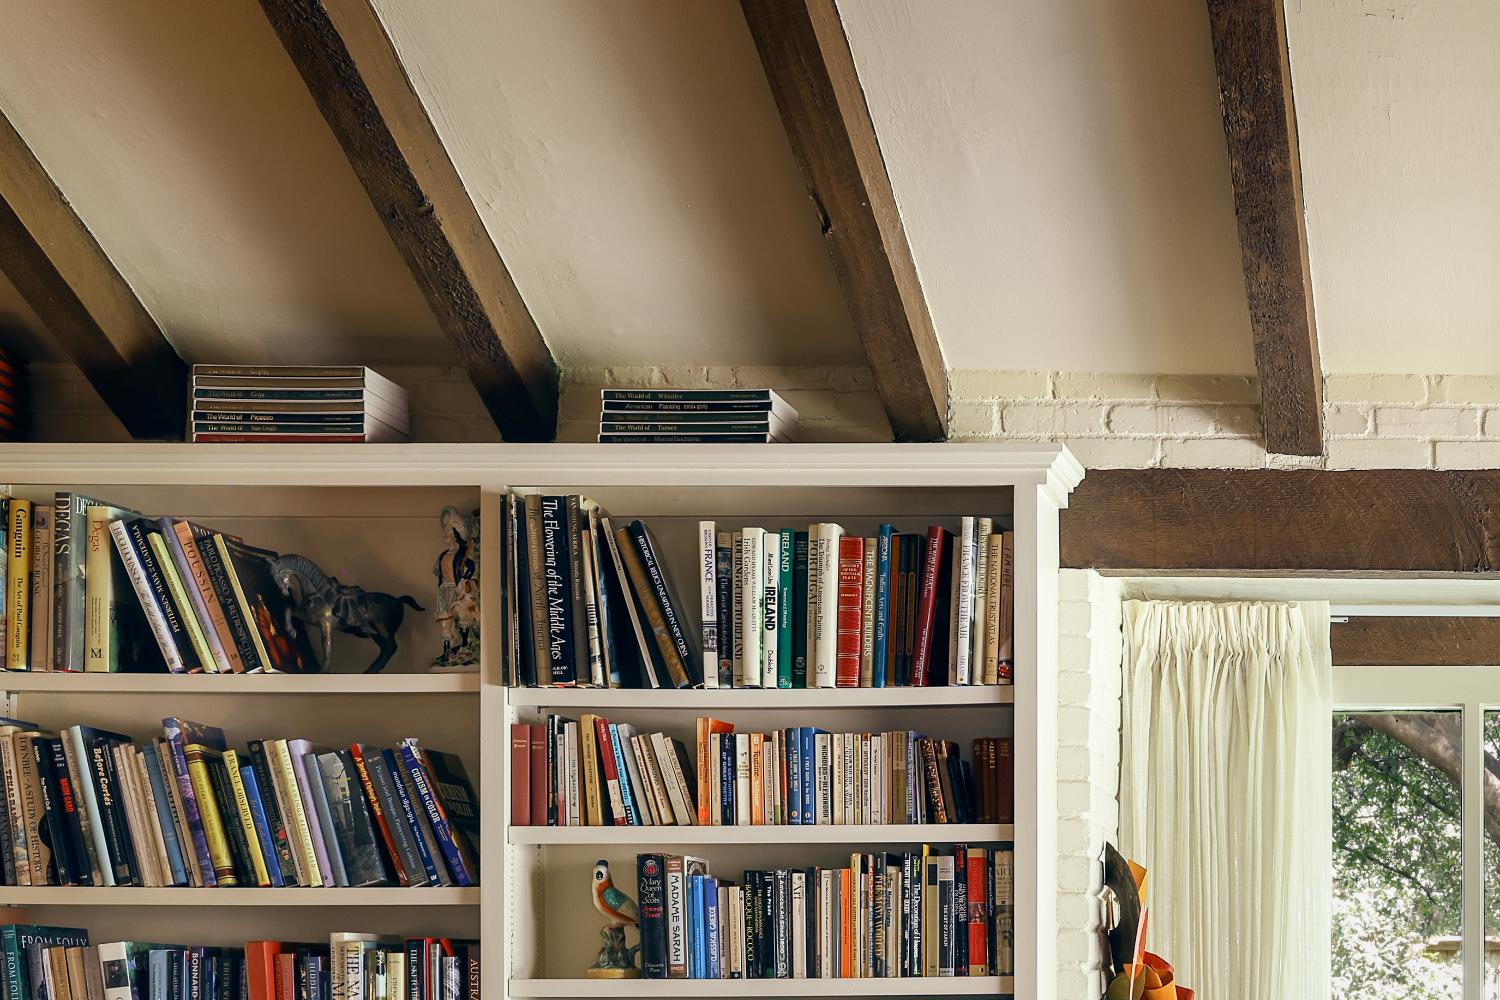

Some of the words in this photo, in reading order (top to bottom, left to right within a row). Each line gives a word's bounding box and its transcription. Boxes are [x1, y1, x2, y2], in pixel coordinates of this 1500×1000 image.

[55, 496, 70, 555] DEGAS
[543, 500, 558, 517] The
[12, 508, 27, 558] Gauguin
[91, 520, 104, 552] Degas
[544, 521, 562, 566] Flowering
[705, 549, 713, 582] FRANCE
[782, 532, 790, 572] IRELAND
[866, 550, 874, 566] THE
[962, 545, 970, 579] FRANCE
[183, 541, 214, 604] POUSSIN
[546, 569, 562, 578] of
[548, 581, 562, 595] the
[808, 539, 818, 608] PORTUGAL
[990, 560, 998, 599] NATIONAL
[637, 536, 654, 568] HISTORICAL
[670, 624, 681, 637] NEW
[677, 638, 688, 657] CHINA
[765, 586, 775, 631] IRELAND
[865, 567, 873, 620] MAGNIFICENT
[961, 580, 969, 604] FROM
[550, 598, 564, 633] Middle
[989, 601, 997, 622] TRUST
[550, 634, 566, 659] Ages
[864, 622, 872, 656] BUILDERS
[988, 623, 996, 645] ATLAS
[5, 769, 15, 798] TEXAS
[93, 748, 104, 777] Before
[99, 778, 112, 806] Cortés
[411, 768, 428, 794] CUBISM
[422, 800, 441, 824] COLOR
[671, 875, 680, 923] MADAME
[346, 946, 360, 974] THE
[672, 926, 680, 962] SARAH
[746, 927, 754, 961] ROCOCO
[6, 952, 17, 978] FROM
[191, 953, 199, 998] BONNARD
